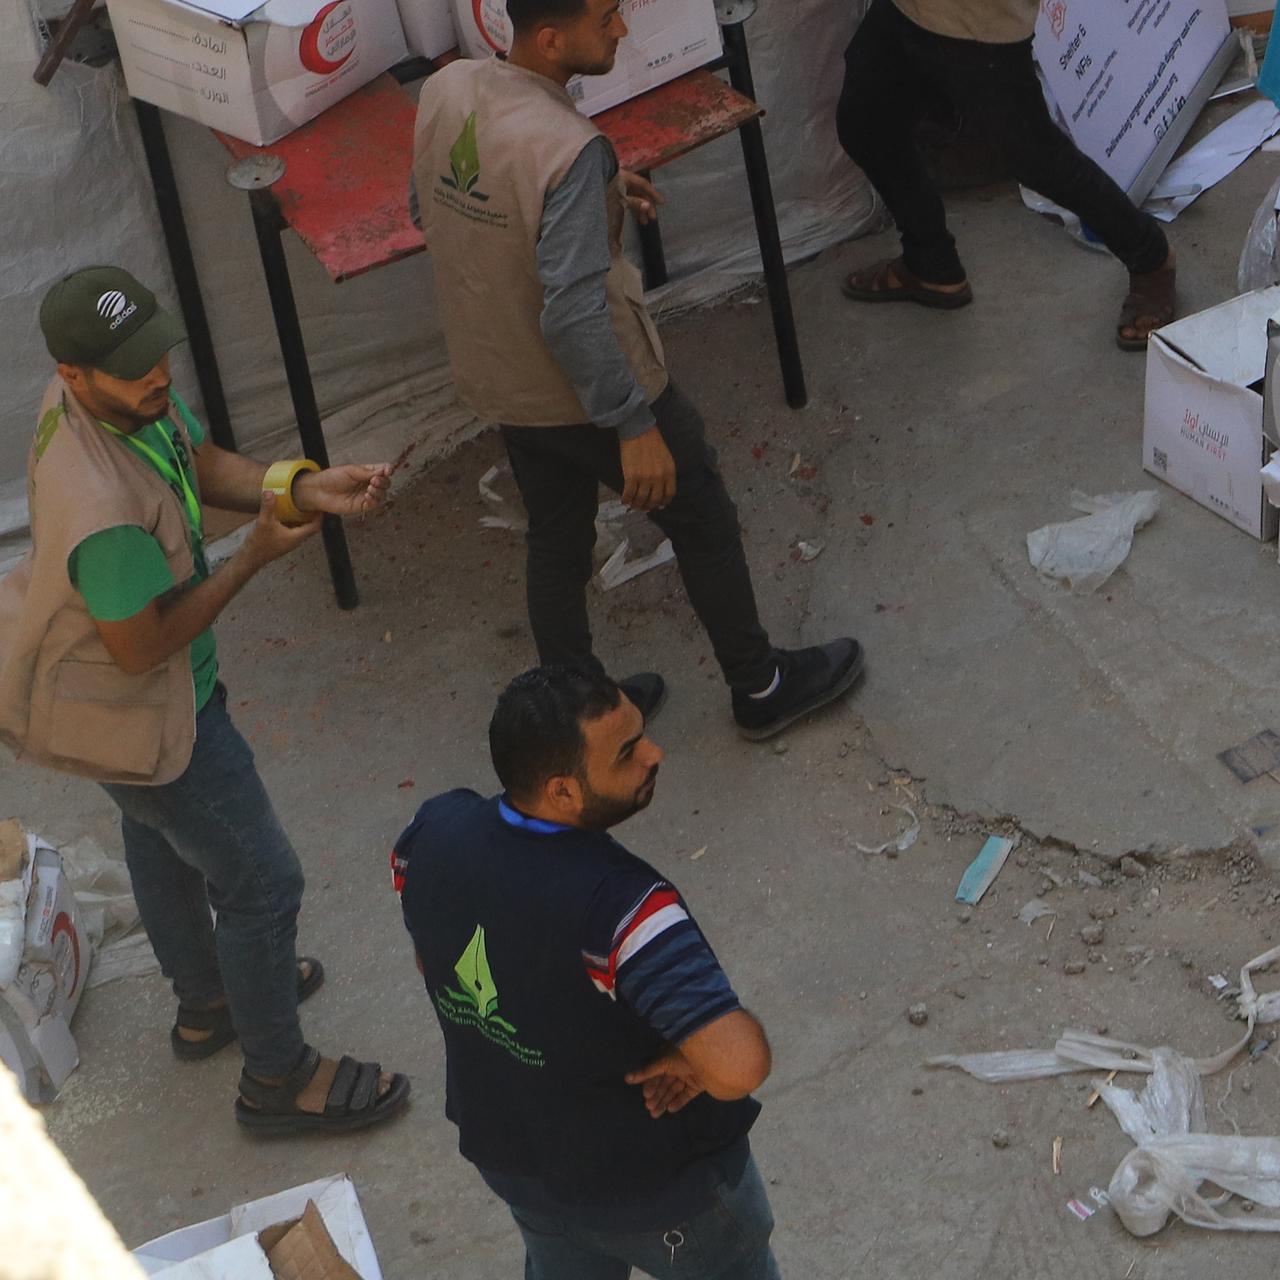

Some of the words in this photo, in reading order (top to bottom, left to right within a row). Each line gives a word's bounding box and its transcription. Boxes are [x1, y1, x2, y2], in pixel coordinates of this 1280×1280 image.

[1058, 33, 1082, 71] Shelter
[109, 302, 138, 331] adidas
[1179, 426, 1205, 451] HUMAN
[1205, 440, 1227, 463] FIRST
